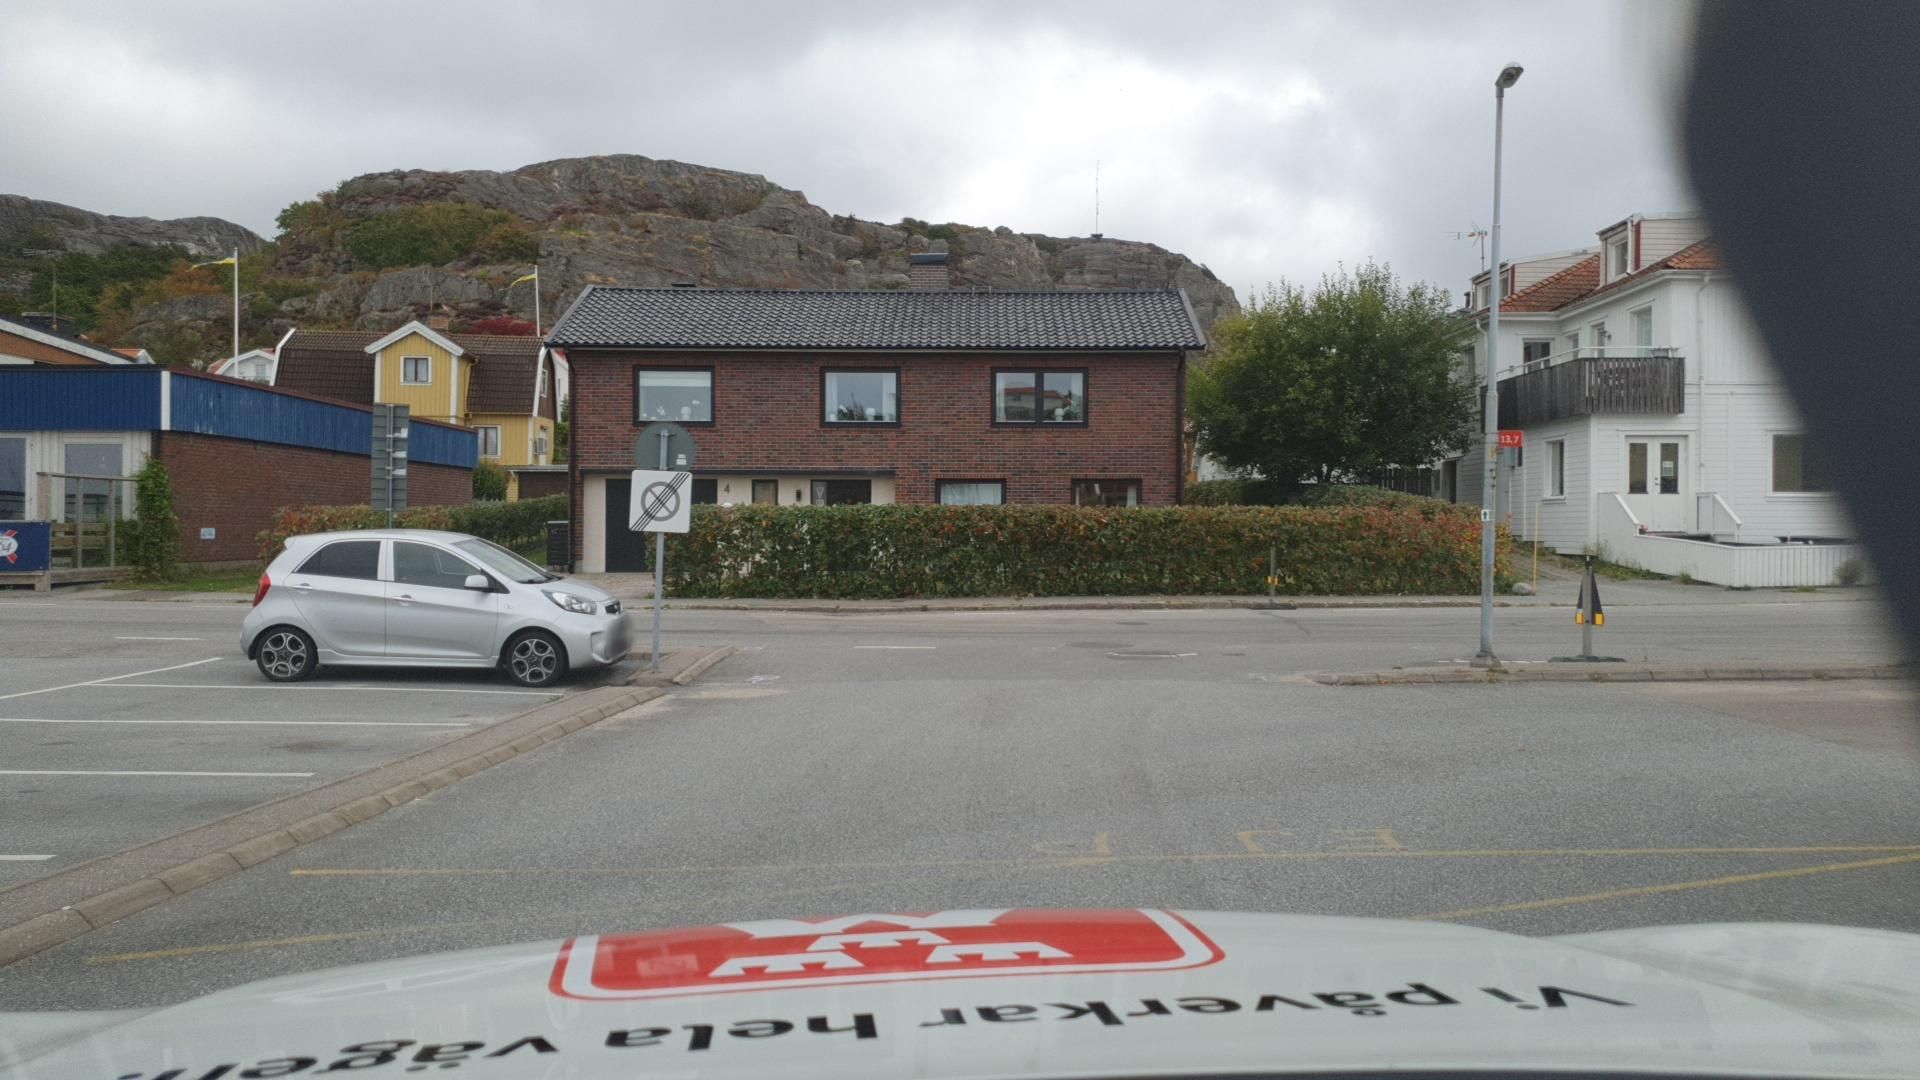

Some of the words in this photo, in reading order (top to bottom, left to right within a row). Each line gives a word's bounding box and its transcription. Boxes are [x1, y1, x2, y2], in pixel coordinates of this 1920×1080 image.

[1500, 435, 1520, 444] 13,7
[723, 483, 731, 494] 4
[919, 982, 1462, 1027] påverkar
[1478, 986, 1638, 1011] Vi
[604, 1012, 879, 1052] hela
